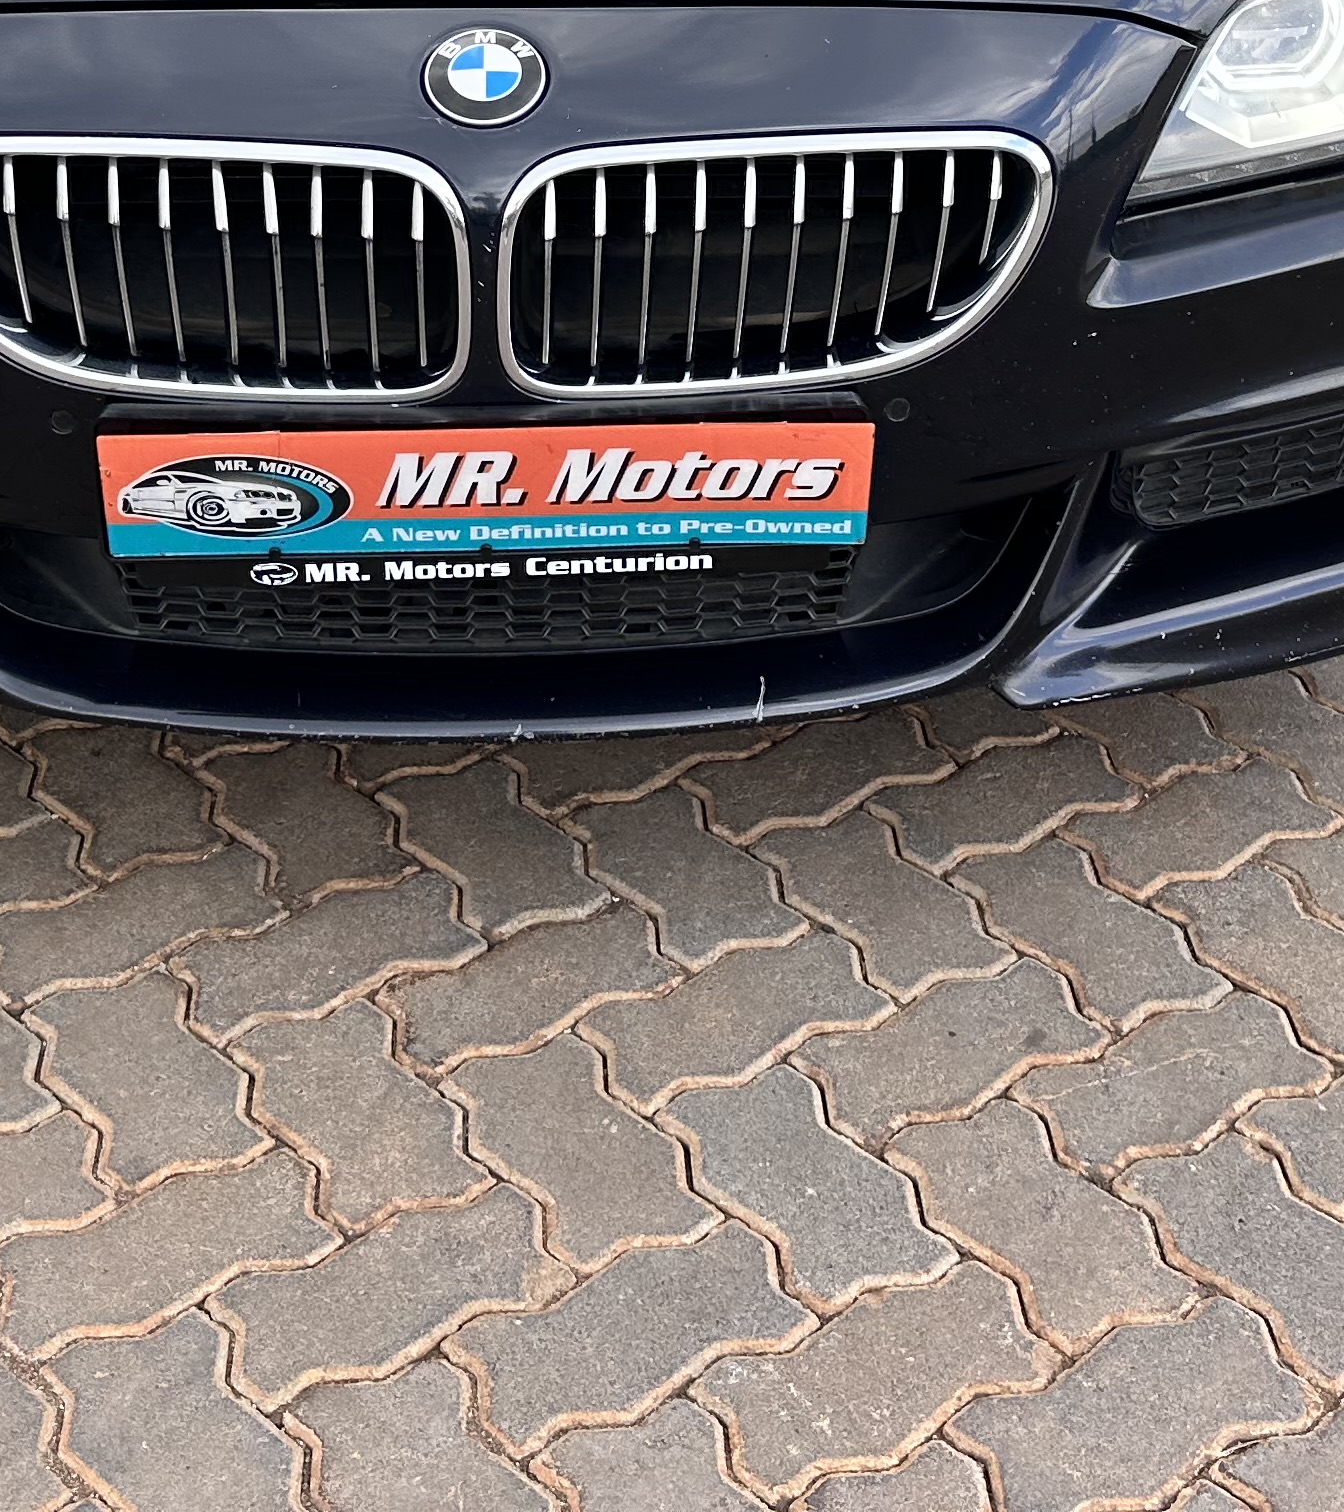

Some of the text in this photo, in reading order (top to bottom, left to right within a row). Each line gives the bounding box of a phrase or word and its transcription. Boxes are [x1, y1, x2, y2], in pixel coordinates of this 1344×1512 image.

[437, 31, 535, 59] BMW
[215, 460, 339, 494] MR. MOTORS
[376, 447, 844, 508] MR. Motors
[361, 518, 852, 542] A New Definition to Pre-Owned
[304, 553, 713, 583] MR. Motors Centurion
